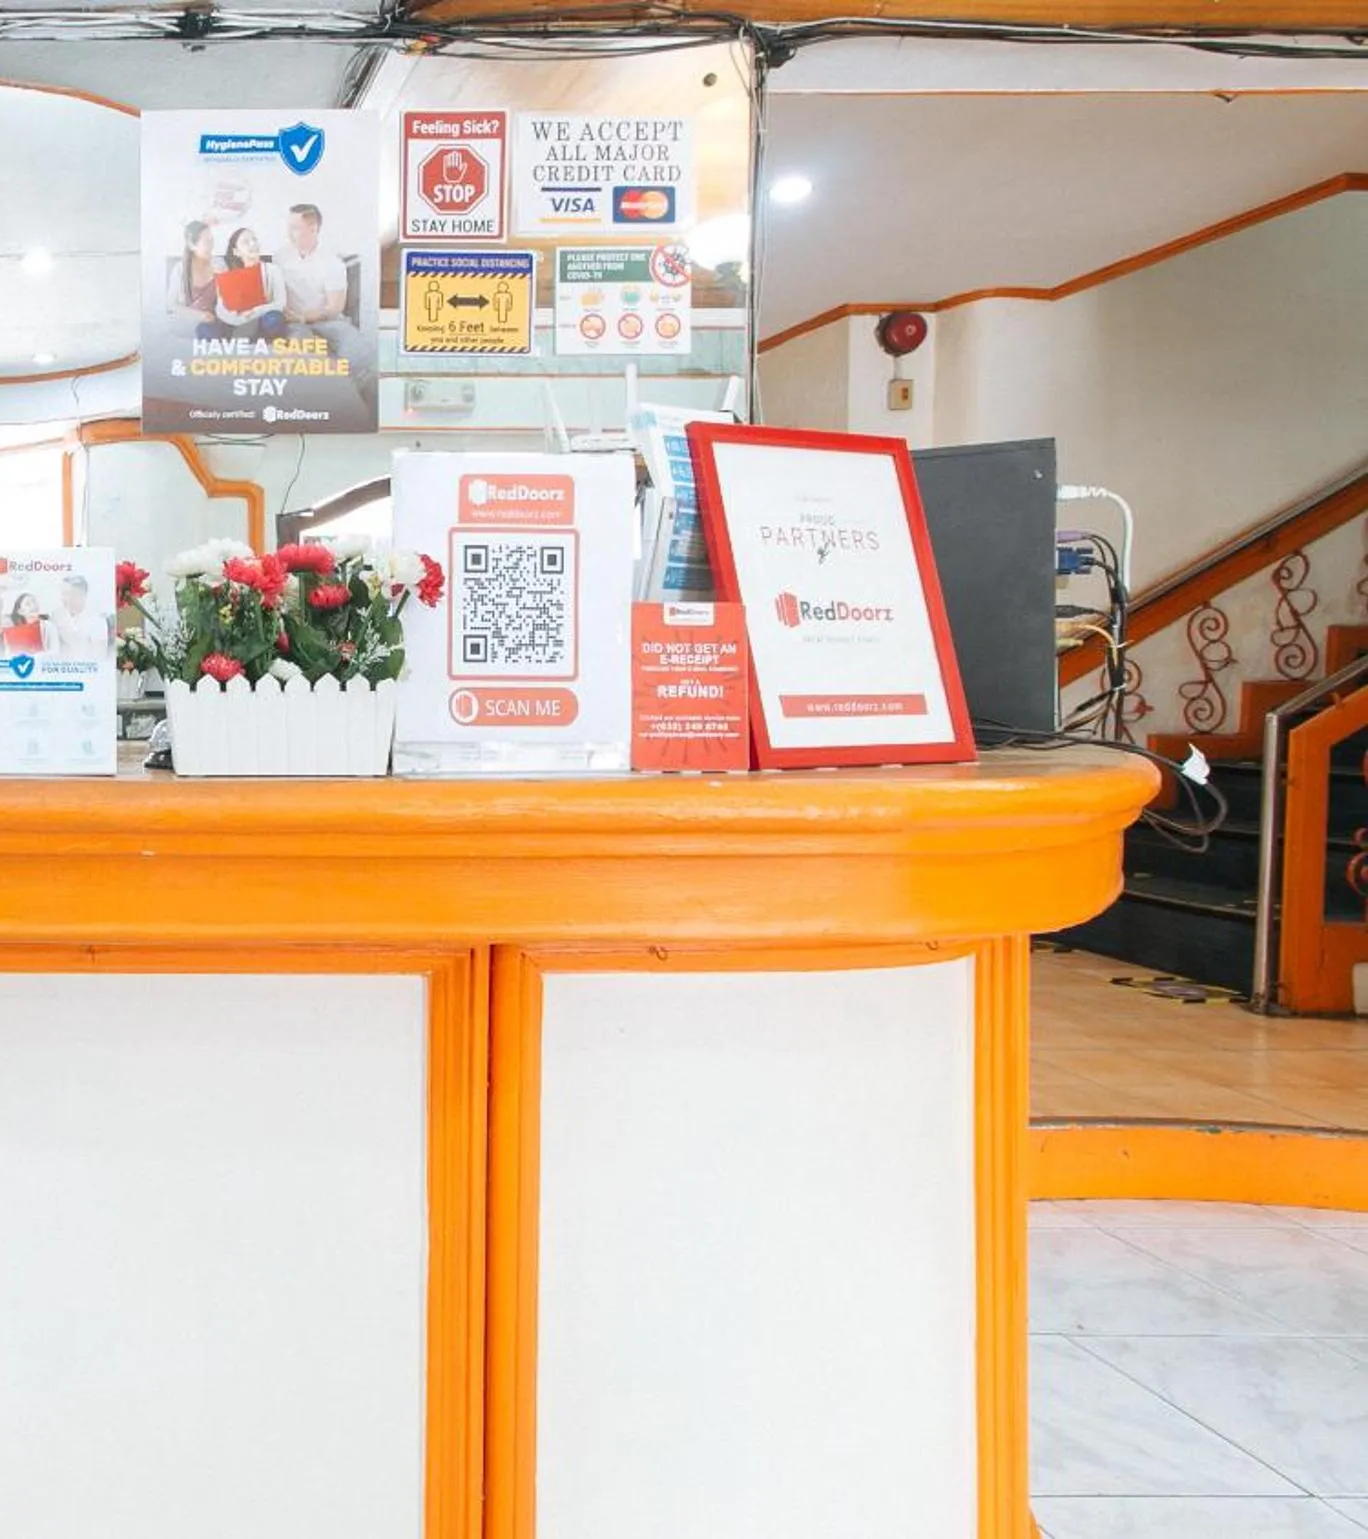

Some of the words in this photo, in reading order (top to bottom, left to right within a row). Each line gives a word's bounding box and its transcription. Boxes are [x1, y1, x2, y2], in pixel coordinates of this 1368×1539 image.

[412, 119, 460, 136] Feeling
[463, 119, 500, 134] Sick?
[532, 121, 570, 142] WE
[580, 121, 684, 142] ACCEPT
[545, 145, 587, 162] ALL
[595, 145, 670, 163] MAJOR
[532, 165, 614, 183] CREDIT
[623, 165, 682, 183] CARD
[433, 184, 475, 204] STOP
[551, 197, 596, 213] VISA
[412, 219, 447, 234] STAY
[452, 219, 494, 233] HOME
[411, 257, 449, 267] PRACTICE
[451, 258, 479, 268] SOCIAL
[480, 258, 530, 268] DISTANCING
[448, 321, 457, 333] 6
[459, 321, 485, 333] Feet
[193, 338, 250, 356] HAVE
[253, 339, 270, 356] A
[272, 338, 328, 356] SAFE
[171, 360, 187, 376] &
[190, 358, 350, 377] COMFORTABLE
[233, 378, 288, 397] STAY
[276, 409, 330, 421] RedDoorz
[486, 484, 566, 501] RedDoorz
[759, 525, 881, 552] PARTNERS
[8, 560, 73, 572] RedDoorz
[800, 600, 895, 622] RedDoorz
[642, 642, 663, 654] DID
[666, 642, 692, 654] NOT
[694, 642, 718, 654] GET
[720, 642, 737, 654] AN
[659, 654, 720, 666] E-RECEIPT
[657, 684, 725, 699] REFUND!
[485, 699, 530, 716] SCAN
[535, 700, 561, 716] ME
